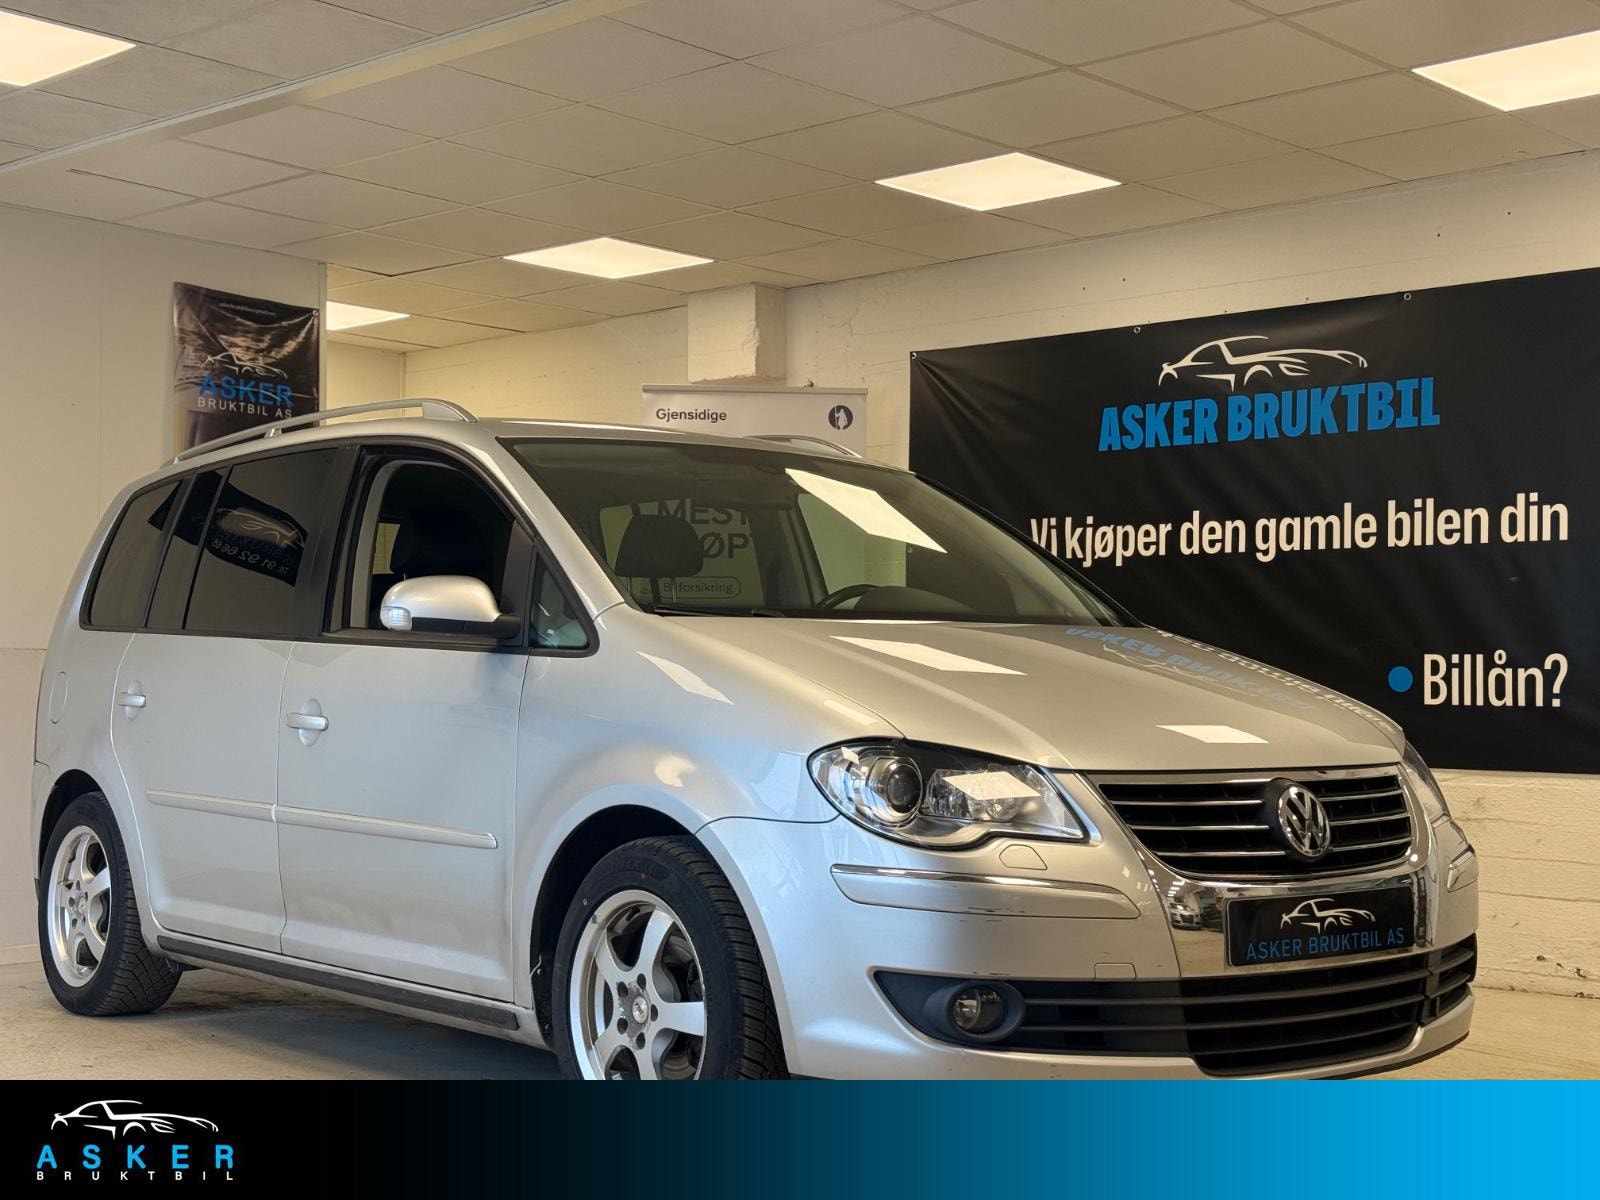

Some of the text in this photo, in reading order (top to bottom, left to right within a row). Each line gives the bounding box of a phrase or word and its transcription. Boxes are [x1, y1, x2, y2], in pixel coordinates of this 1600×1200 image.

[198, 371, 294, 408] ASKER
[198, 396, 292, 419] BRUKTBIL AS
[656, 408, 727, 424] Gjensidige
[1098, 376, 1440, 452] ASKER BRUKTBIL
[1030, 491, 1569, 567] Vi kjøper den gamle bilen din
[1423, 649, 1568, 708] Billån?
[1246, 927, 1405, 961] ASKER BRUKTBIL AS
